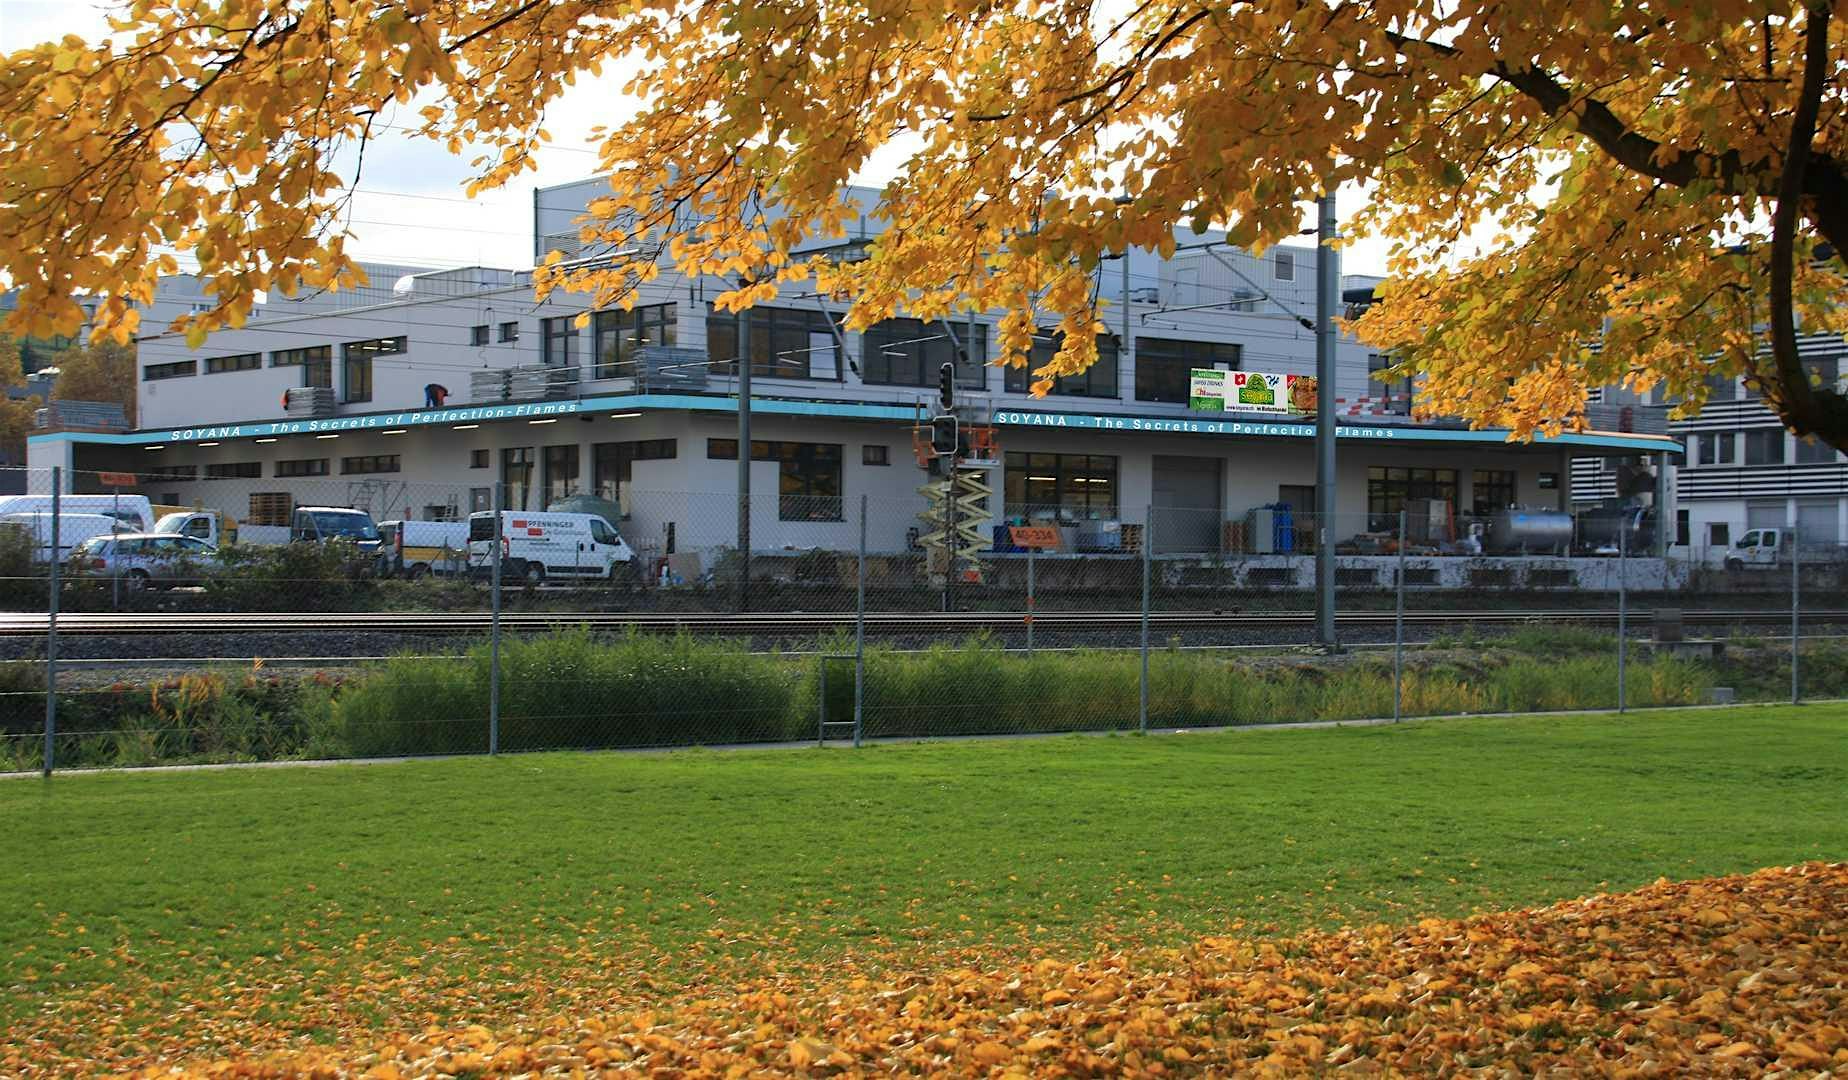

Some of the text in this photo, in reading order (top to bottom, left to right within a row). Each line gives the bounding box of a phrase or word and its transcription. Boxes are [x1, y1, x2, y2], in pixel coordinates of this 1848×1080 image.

[171, 426, 241, 441] SOYANA
[271, 421, 300, 434] The
[309, 417, 377, 432] Secrets
[385, 415, 402, 426] of
[411, 403, 577, 424] Perfection-Flames
[998, 413, 1067, 427] SOYANA
[1095, 416, 1124, 430] The
[1132, 418, 1199, 433] Secrets
[1208, 421, 1224, 433] of
[1233, 424, 1314, 437] Perfectio
